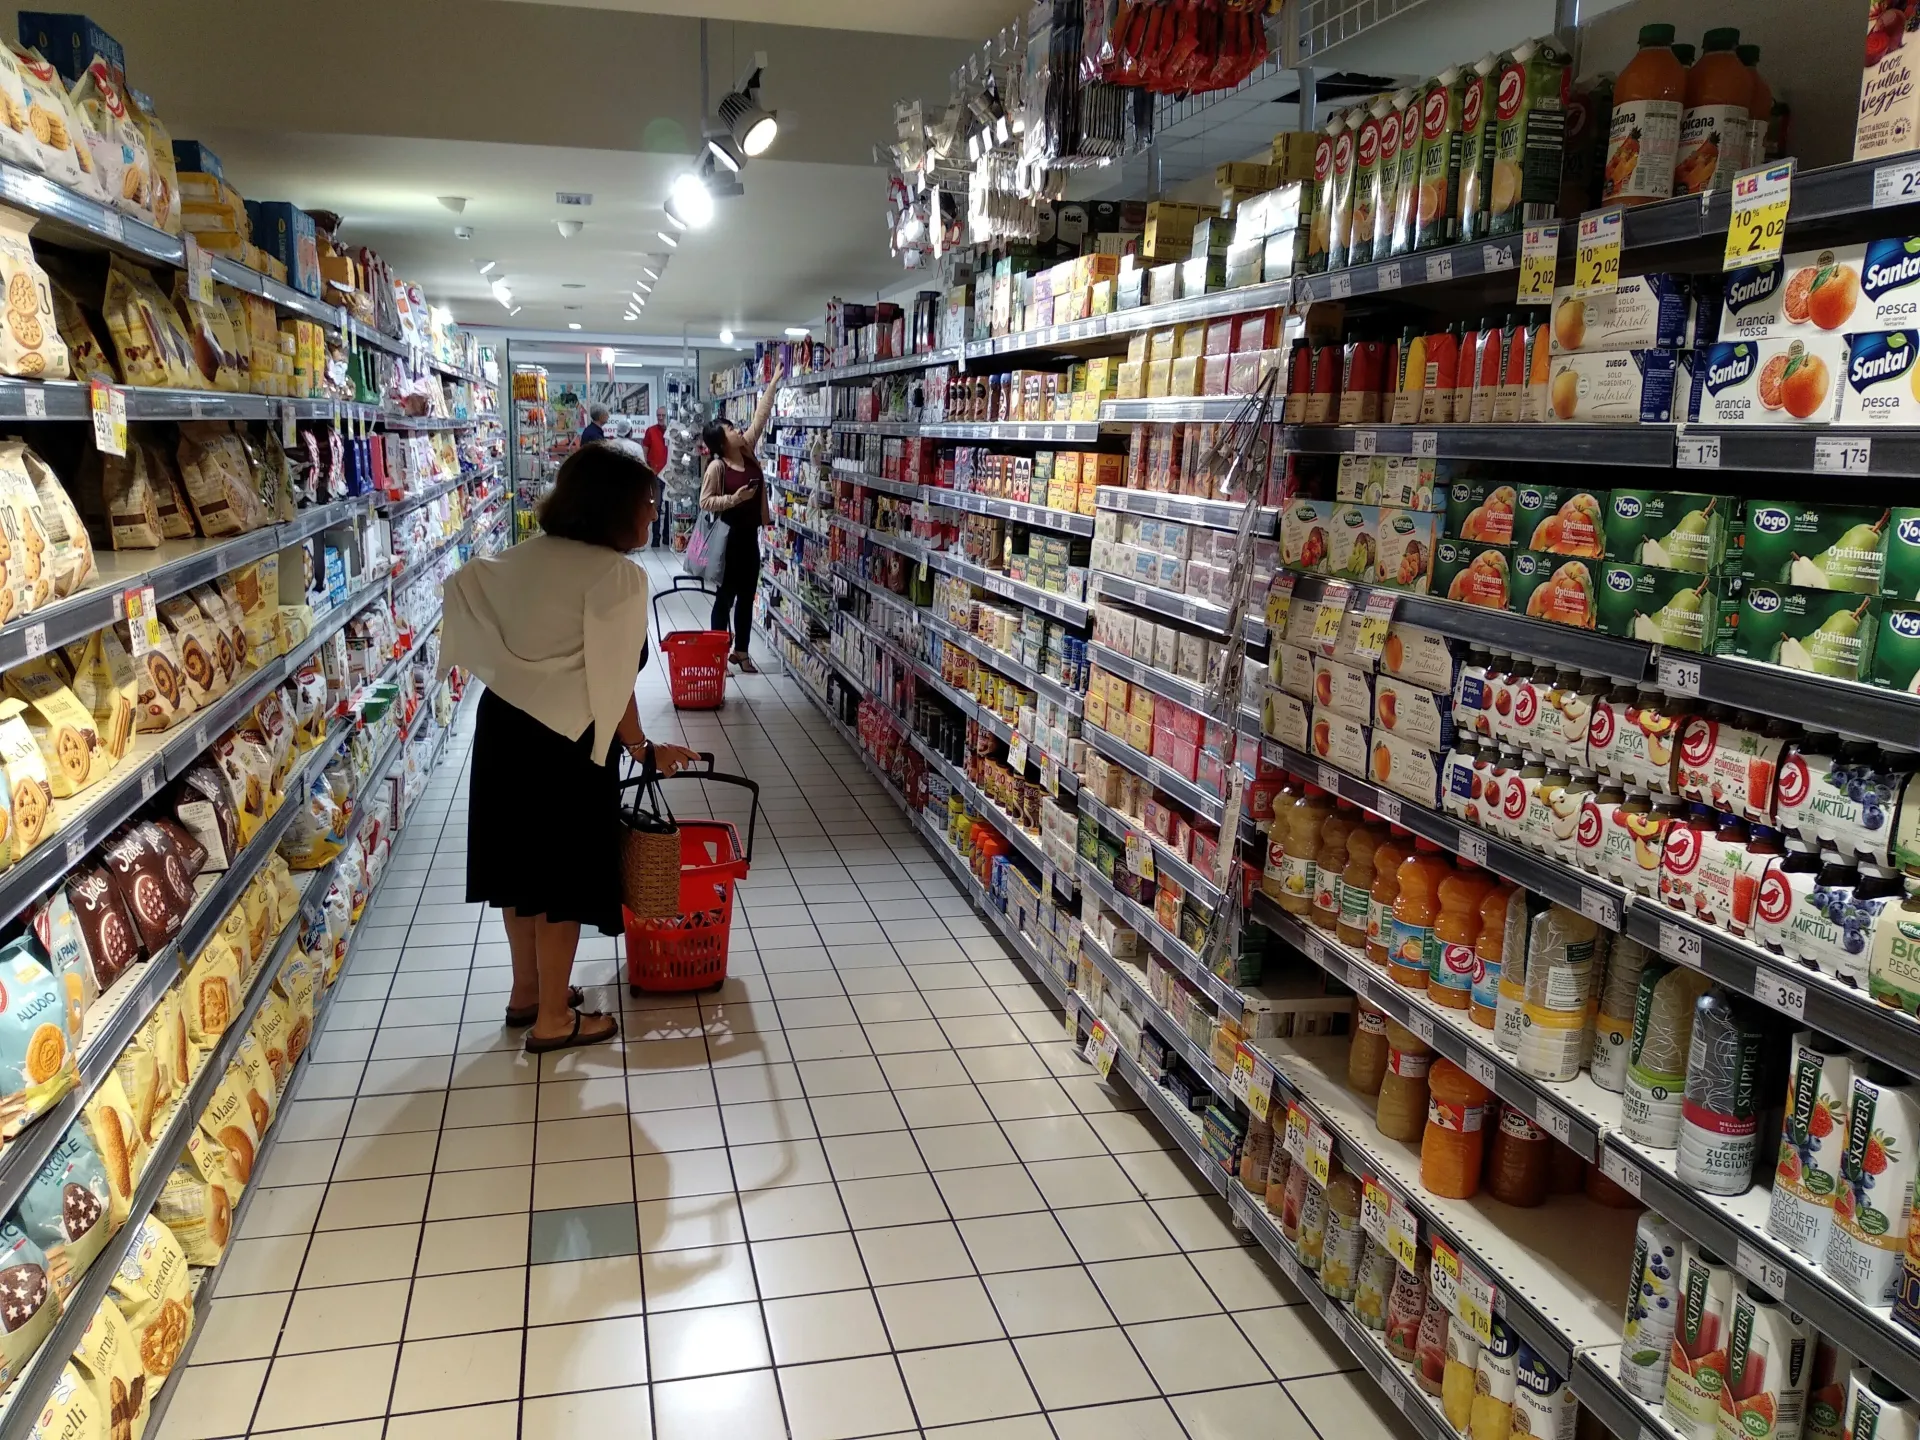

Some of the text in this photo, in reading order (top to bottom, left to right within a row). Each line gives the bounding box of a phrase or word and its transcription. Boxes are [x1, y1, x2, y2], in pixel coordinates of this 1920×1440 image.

[1878, 55, 1903, 75] 100%
[1864, 66, 1911, 97] Frullato
[1861, 82, 1915, 117] veggie
[1865, 261, 1920, 291] Santa
[1616, 284, 1640, 294] ZUEGG
[1728, 270, 1775, 305] Santal
[1876, 302, 1917, 319] pesca
[1736, 312, 1775, 327] arancia
[1739, 326, 1767, 337] rossa
[1606, 359, 1627, 368] ZUEGG
[1708, 352, 1749, 387] Santal
[1851, 345, 1910, 382] Santal
[1715, 396, 1751, 409] arancia
[1862, 396, 1900, 412] pesca
[1718, 408, 1744, 420] rossa
[1520, 491, 1540, 508] Yoga
[1616, 500, 1639, 516] Yoga
[1562, 519, 1594, 532] Optimum
[1758, 512, 1786, 530] Yoga
[1670, 528, 1710, 543] Optimum
[1828, 546, 1883, 562] Optimum
[1517, 556, 1534, 572] Yoga
[1473, 572, 1502, 584] Optimum
[1608, 573, 1630, 590] Yoga
[1325, 586, 1348, 598] Offerta
[1555, 586, 1585, 600] Optimum
[1752, 589, 1777, 610] Yoga
[1368, 596, 1395, 609] Offerta
[1662, 605, 1704, 622] Optimum
[1895, 613, 1920, 635] Yog
[1813, 629, 1862, 648] Optimum
[1540, 711, 1560, 726] PERA
[1618, 732, 1644, 750] PESCA
[1714, 758, 1746, 775] POMODORO
[1529, 808, 1550, 823] PERA
[1809, 797, 1857, 823] MIRTILLI
[1606, 833, 1631, 851] PESCA
[1699, 868, 1729, 887] POMODORO
[1799, 908, 1814, 917] Succo
[1791, 916, 1838, 944] MIRTILLI
[1632, 996, 1649, 1056] SKIPPER
[1799, 1050, 1823, 1066] ZUEGG
[1737, 1045, 1758, 1107] SKIPPER
[1854, 1080, 1878, 1099] ZUEGG
[1795, 1065, 1815, 1132] SKIPPER
[1506, 1112, 1525, 1126] Yoga
[1849, 1099, 1870, 1167] SKIPPER
[1706, 1149, 1755, 1160] ZUCCHE
[1705, 1158, 1752, 1169] AGGIUNT
[1812, 1170, 1827, 1180] SOLO
[1774, 1189, 1798, 1207] ENZA
[1797, 1186, 1830, 1206] Bosco
[1864, 1209, 1882, 1219] SOLO
[1830, 1224, 1853, 1245] ENZA
[1850, 1225, 1883, 1246] Bosco
[1686, 1276, 1704, 1335] SKIPPER
[1732, 1313, 1749, 1376] SKIPPER
[1483, 1353, 1511, 1376] ananas
[1517, 1367, 1550, 1392] antal
[1521, 1390, 1552, 1414] ananas
